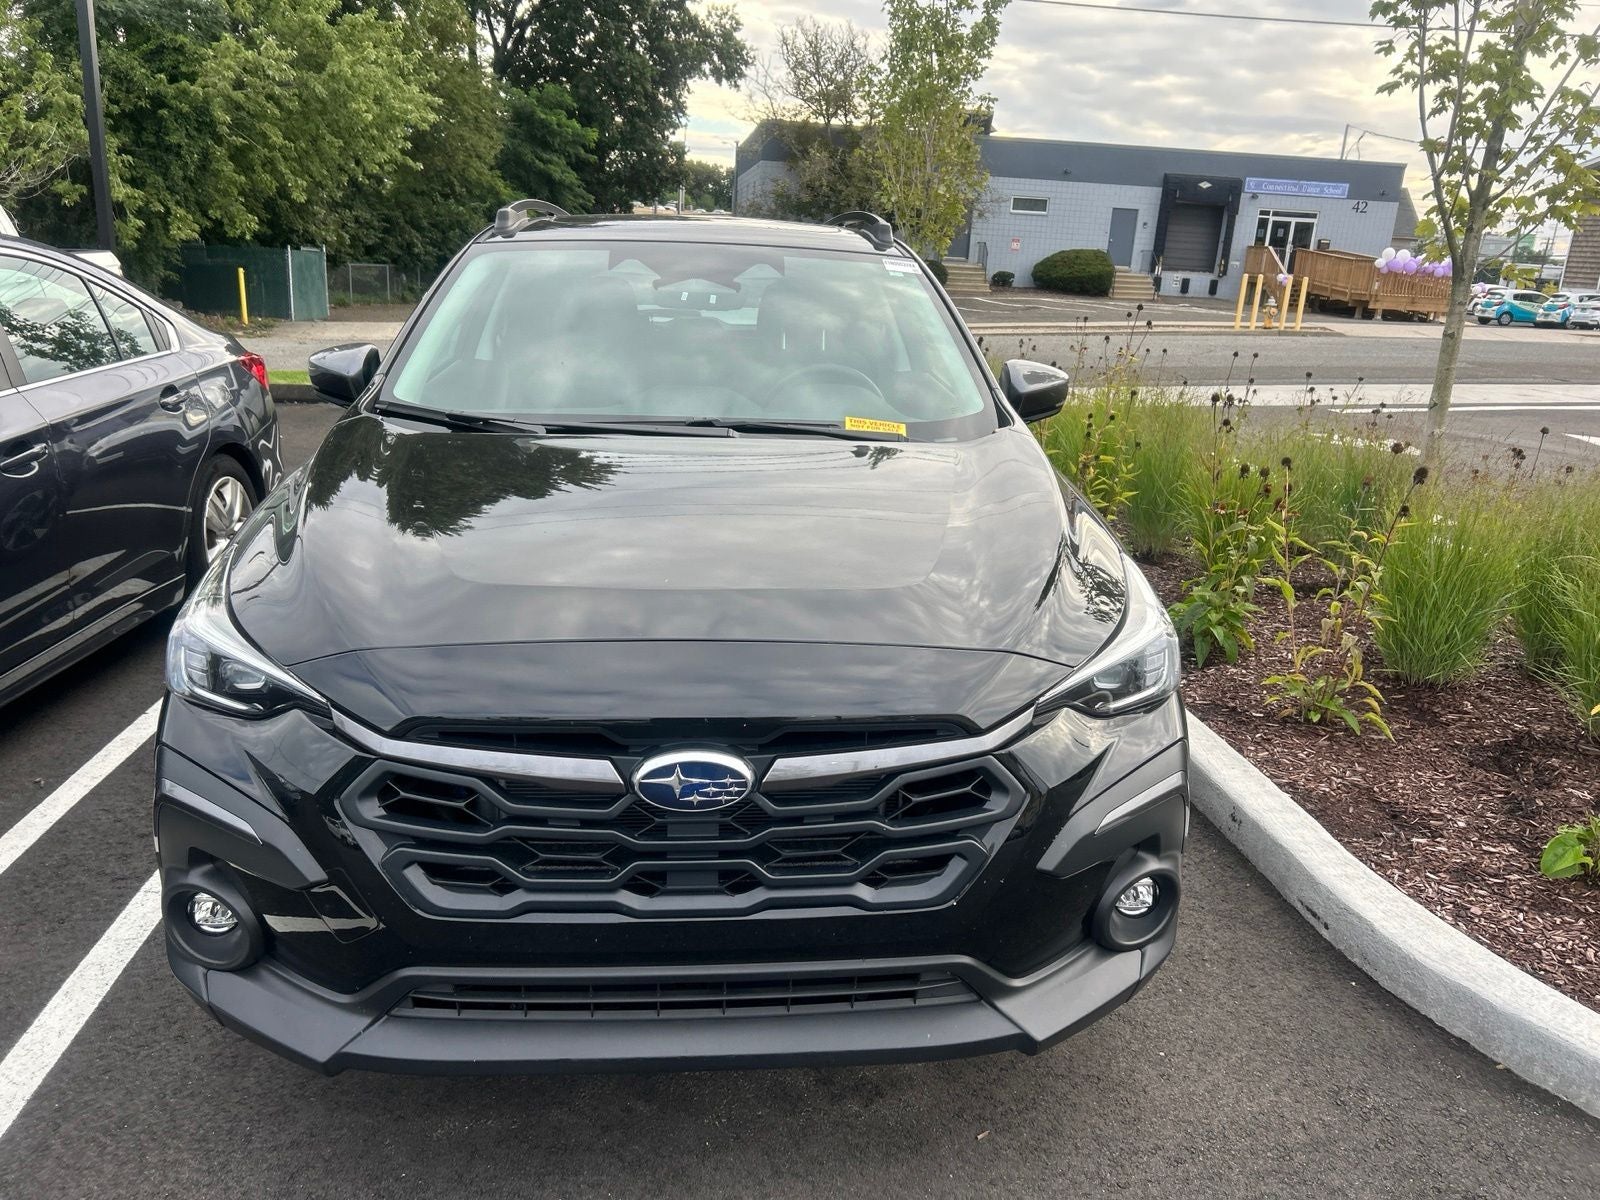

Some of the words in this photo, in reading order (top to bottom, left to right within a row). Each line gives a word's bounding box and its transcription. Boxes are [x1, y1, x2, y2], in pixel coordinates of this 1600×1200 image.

[1323, 186, 1343, 194] School
[1352, 201, 1368, 213] 42
[869, 421, 901, 429] VEHICLE
